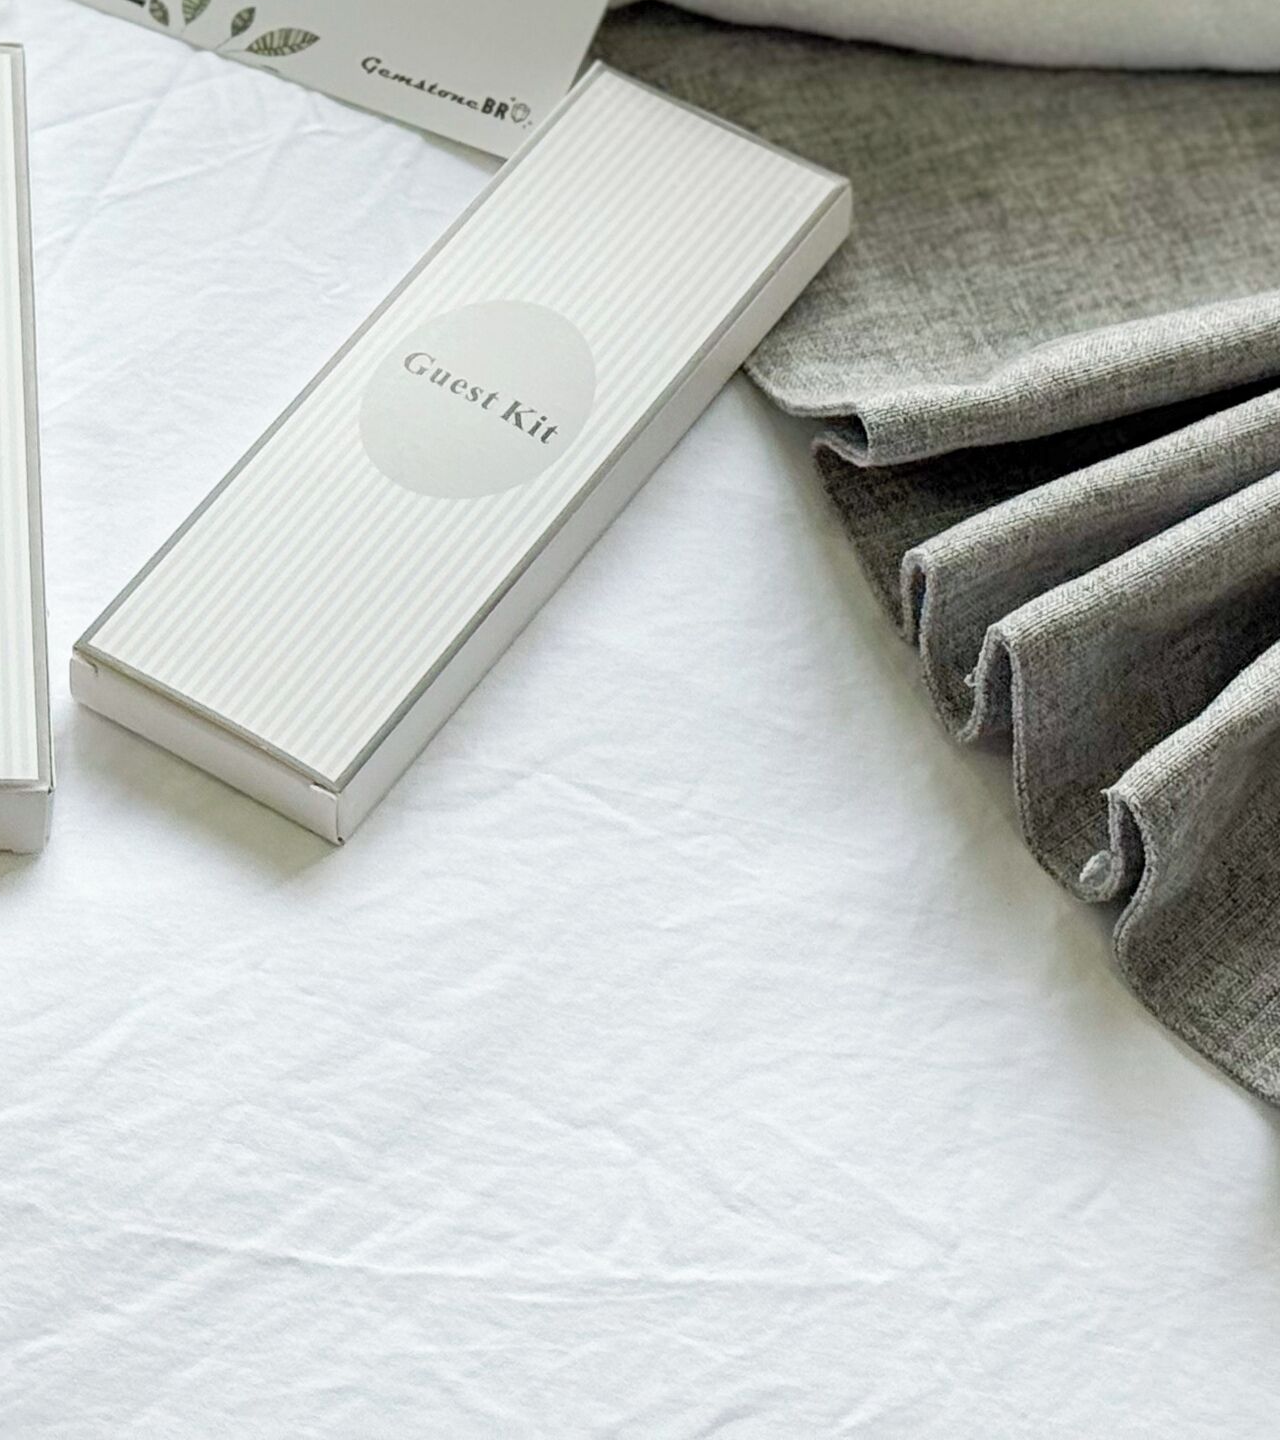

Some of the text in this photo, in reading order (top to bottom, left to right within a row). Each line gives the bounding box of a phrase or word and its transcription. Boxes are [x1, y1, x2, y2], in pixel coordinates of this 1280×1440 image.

[360, 56, 510, 121] GemstoneBR
[403, 351, 559, 445] Guest Kit
